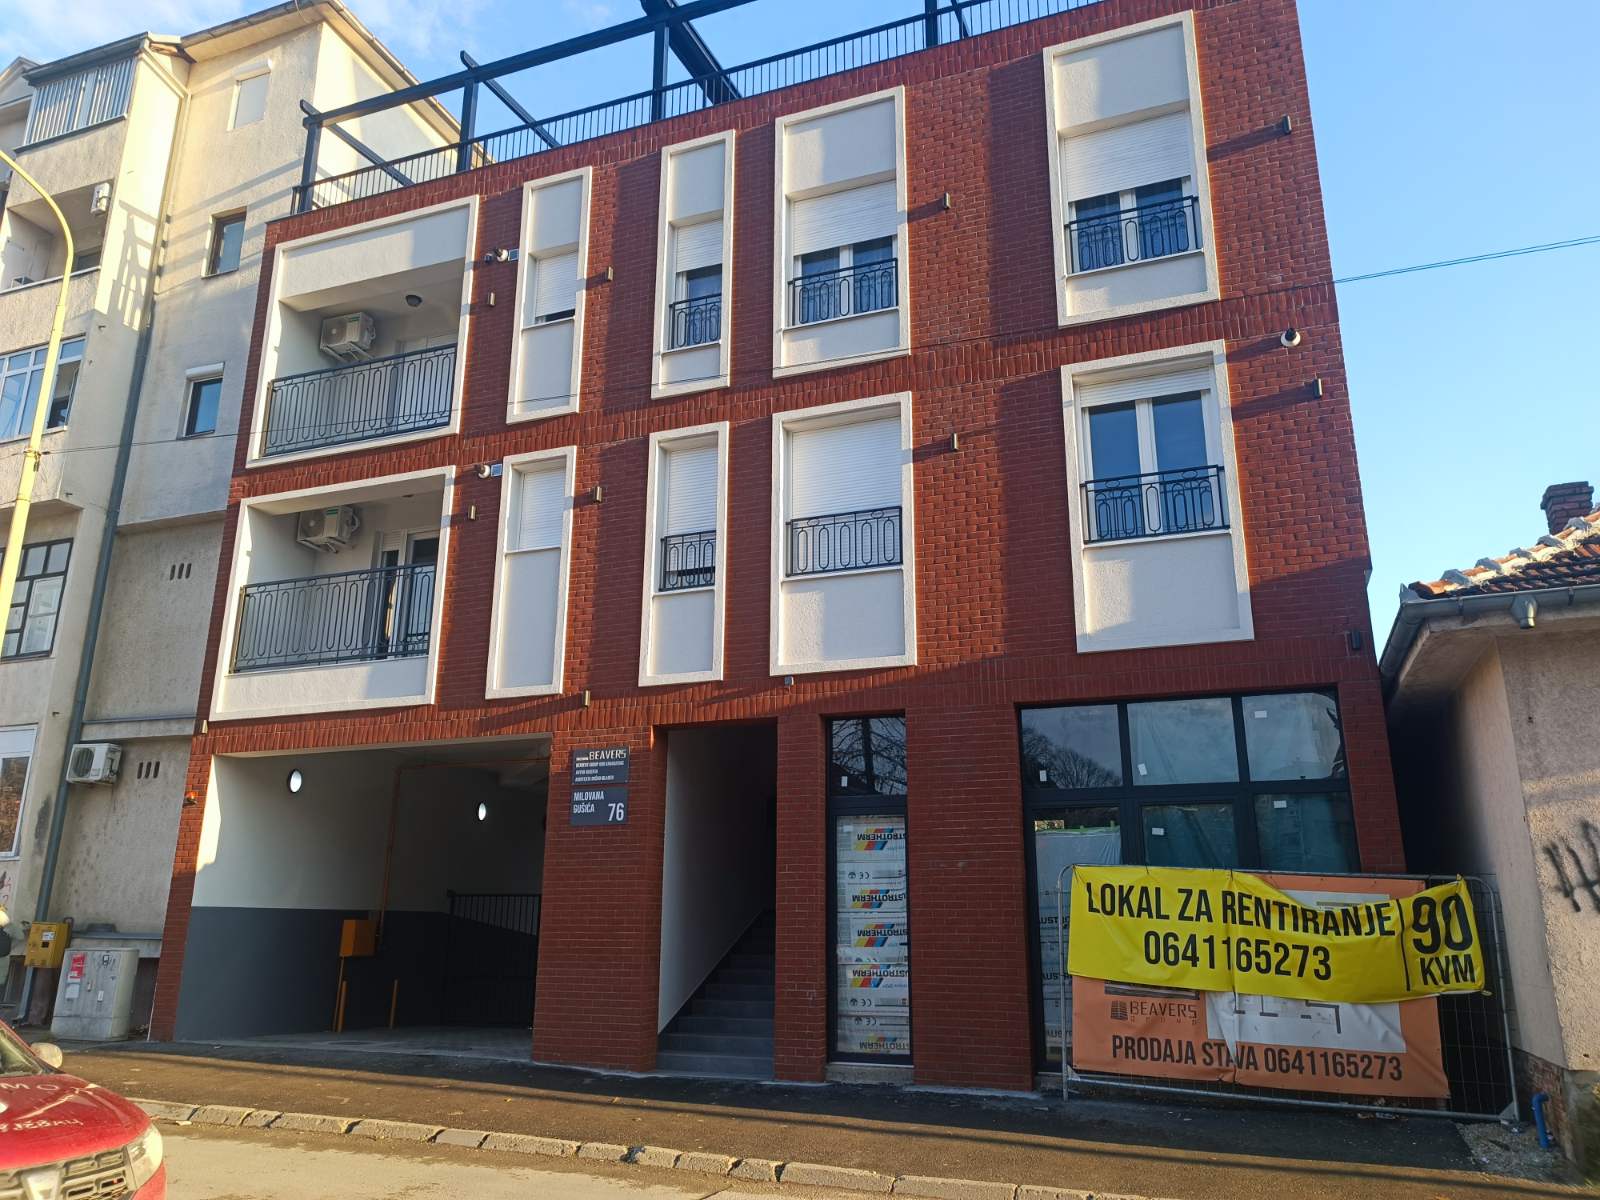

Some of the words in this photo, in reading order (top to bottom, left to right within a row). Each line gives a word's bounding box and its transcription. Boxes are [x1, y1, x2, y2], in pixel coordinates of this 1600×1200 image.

[589, 750, 626, 760] BEAVERS
[574, 791, 604, 801] MILOVANA
[608, 803, 625, 821] 76
[1086, 881, 1170, 920] LOKAL
[1177, 888, 1214, 923] ZA
[1221, 889, 1396, 938] RENTIRANJE
[1411, 894, 1473, 955] 90
[1143, 930, 1333, 981] 0641165273
[1419, 954, 1476, 986] KVM
[1130, 1000, 1198, 1019] BEAVERS
[1111, 1034, 1197, 1065] PRODAJA
[1264, 1048, 1404, 1082] 0641165273
